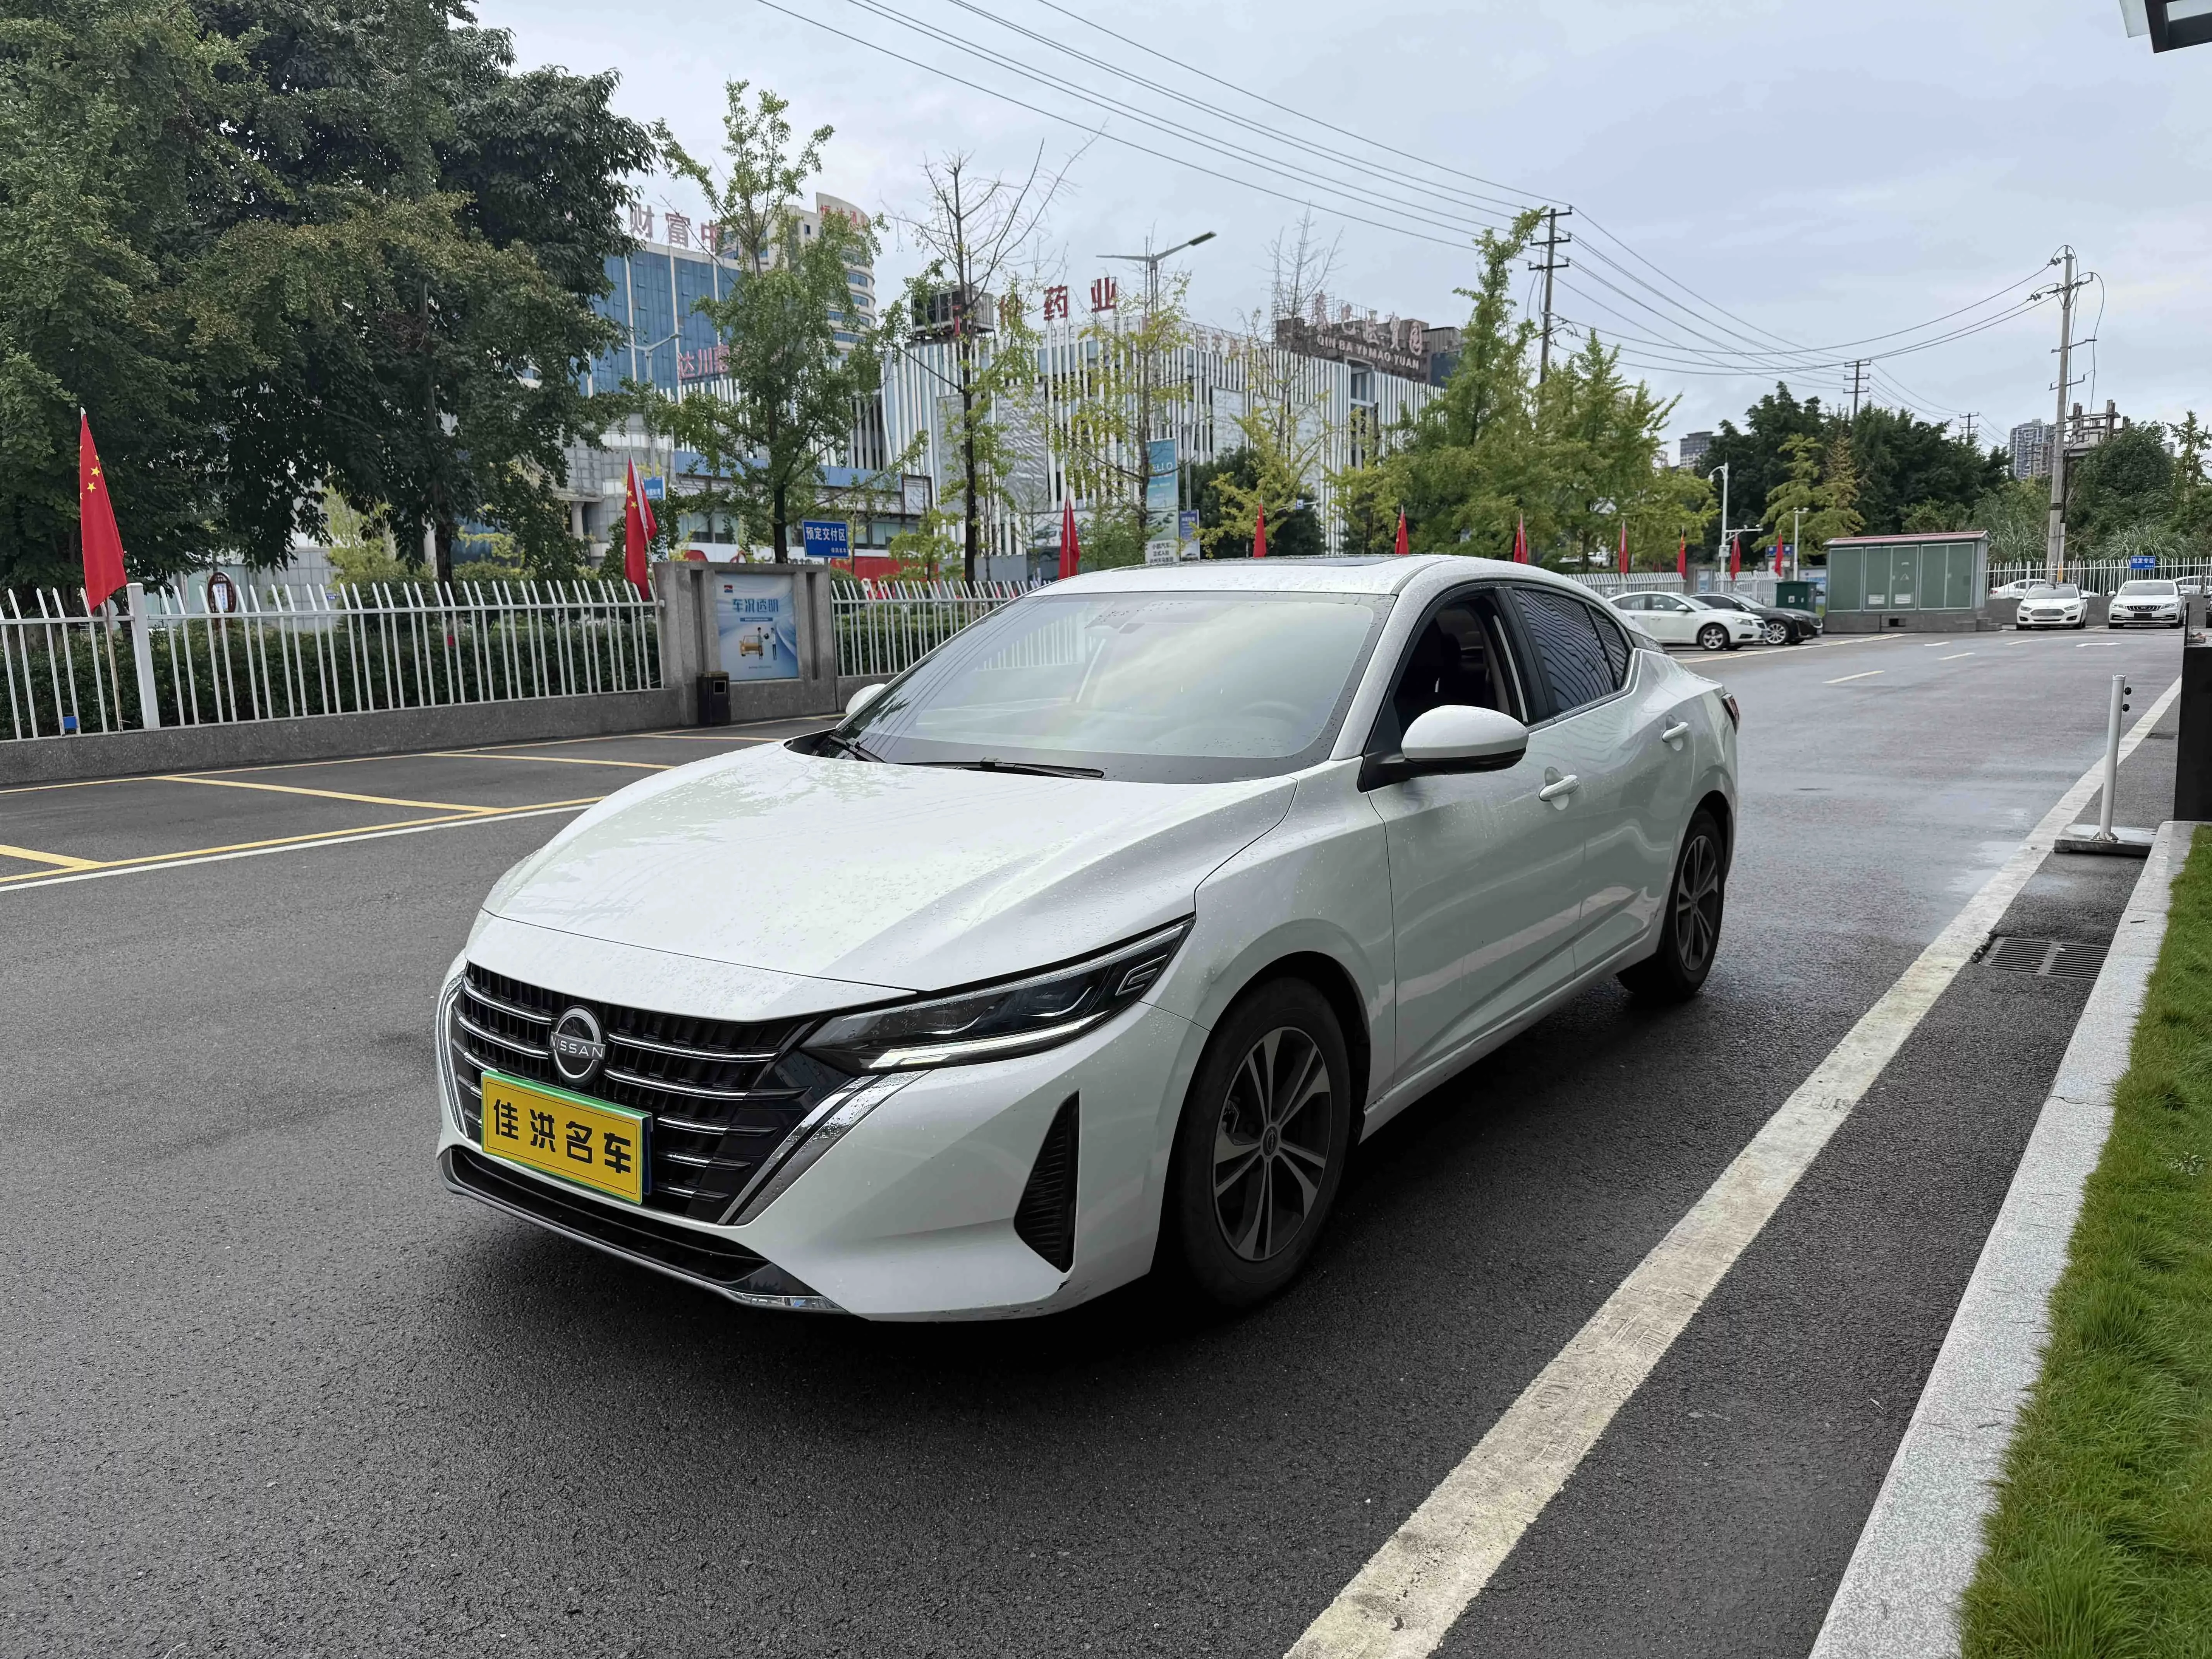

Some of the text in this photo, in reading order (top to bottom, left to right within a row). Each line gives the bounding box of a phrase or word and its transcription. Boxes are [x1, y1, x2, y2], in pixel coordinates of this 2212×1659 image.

[1317, 335, 1336, 348] QIN
[1339, 339, 1353, 353] BA
[1369, 347, 1391, 362] MAO
[1394, 354, 1419, 370] YUAN
[805, 526, 846, 541] 预定交付区
[732, 599, 778, 613] 车况透明
[551, 1035, 603, 1057] NISSAN
[493, 1099, 631, 1174] 佳洪名车
